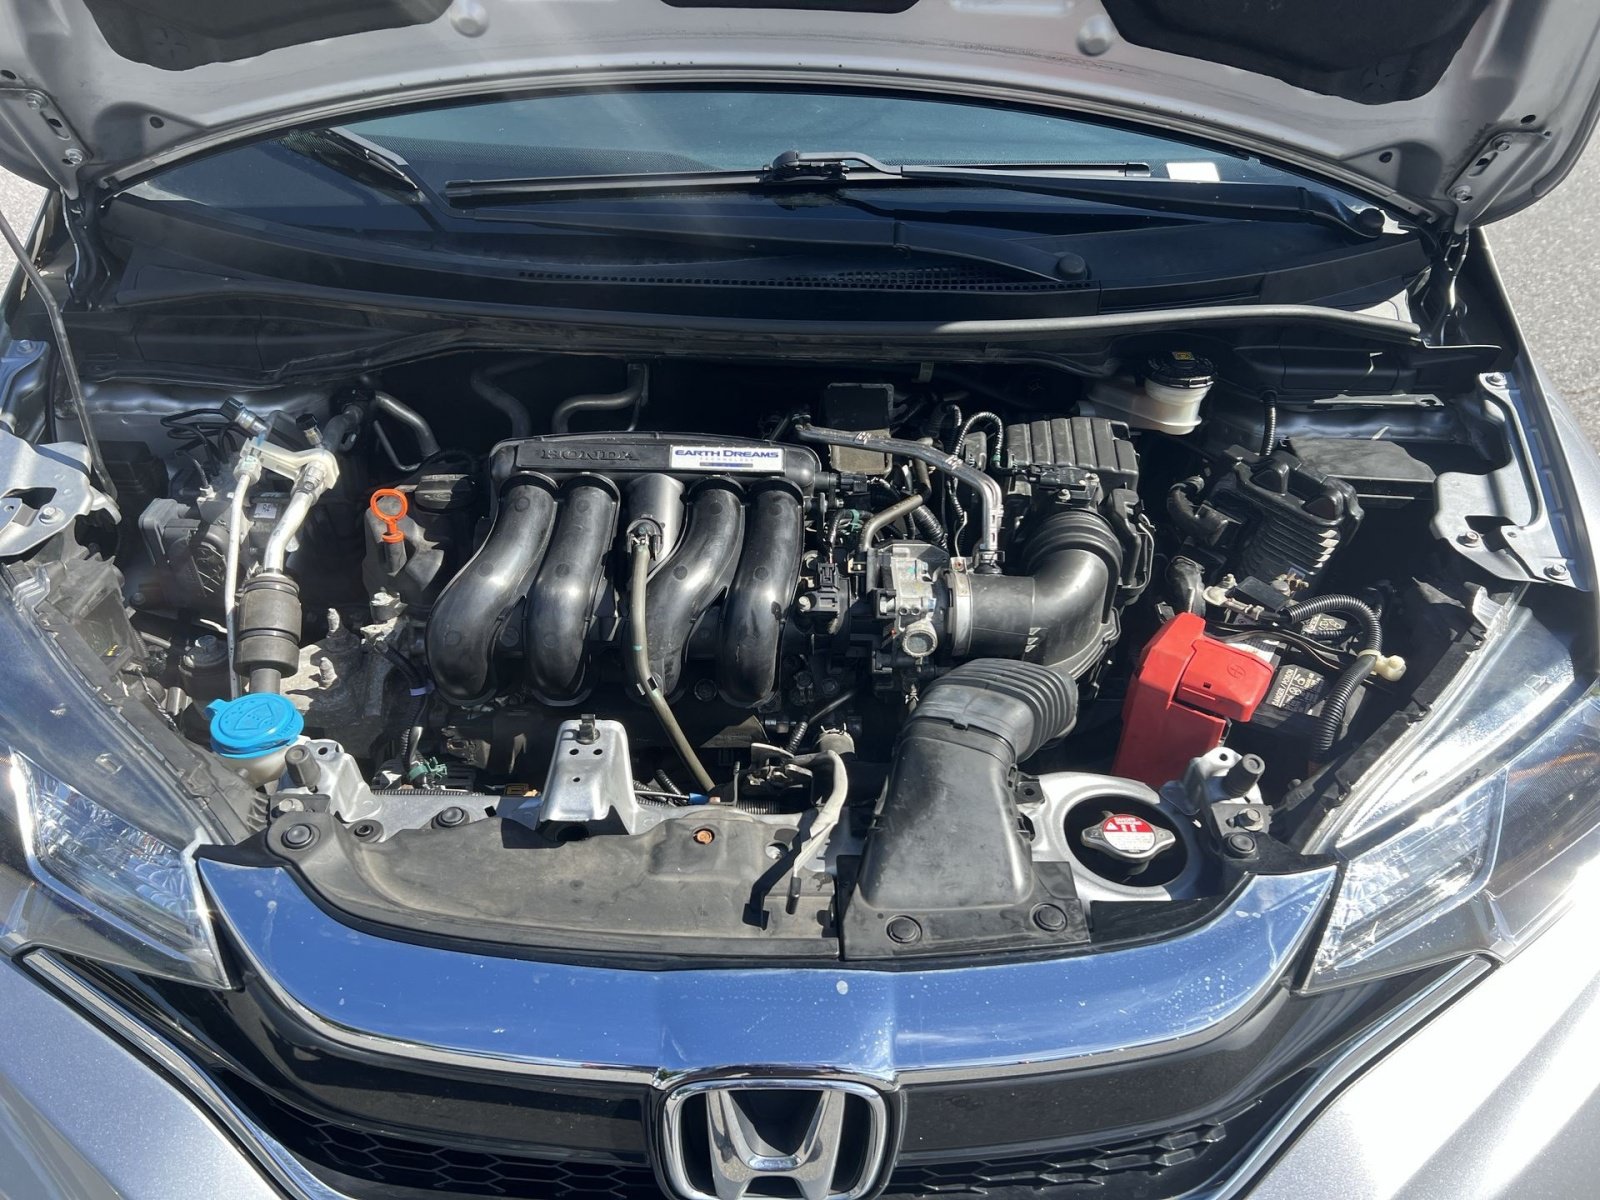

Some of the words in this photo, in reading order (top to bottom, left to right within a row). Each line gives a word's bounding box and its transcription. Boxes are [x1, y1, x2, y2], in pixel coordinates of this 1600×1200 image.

[539, 449, 640, 461] HONDA
[674, 449, 720, 457] EARTH
[723, 449, 779, 458] DREAMS
